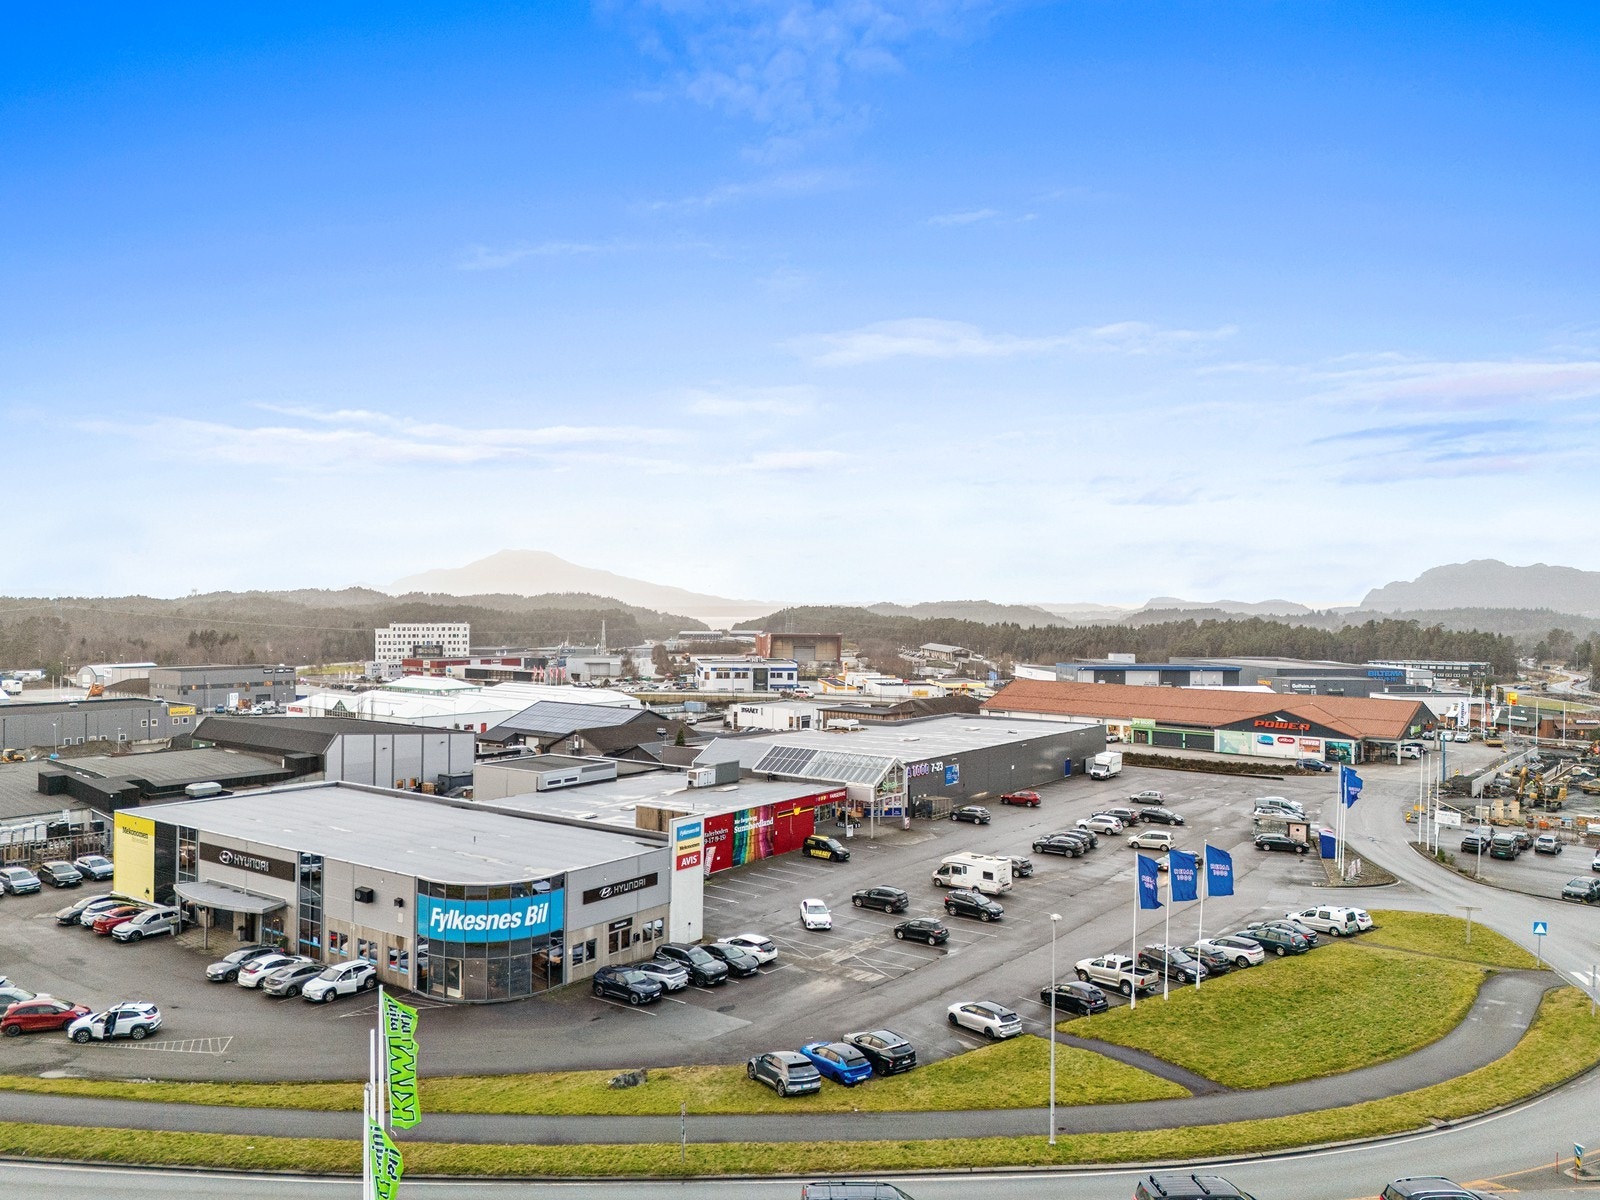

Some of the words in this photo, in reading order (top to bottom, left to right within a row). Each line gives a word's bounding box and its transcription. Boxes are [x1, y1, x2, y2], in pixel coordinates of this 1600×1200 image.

[1254, 720, 1311, 731] POWER
[912, 763, 929, 777] 1000
[931, 761, 943, 772] 7-23
[122, 826, 149, 839] Mekonomen
[233, 854, 269, 872] HYUNDAI
[681, 855, 698, 867] AVIS
[614, 878, 646, 894] HYUNDAI
[430, 907, 522, 933] Fylkesnes
[524, 902, 549, 927] Bil
[388, 1036, 415, 1122] KIWI
